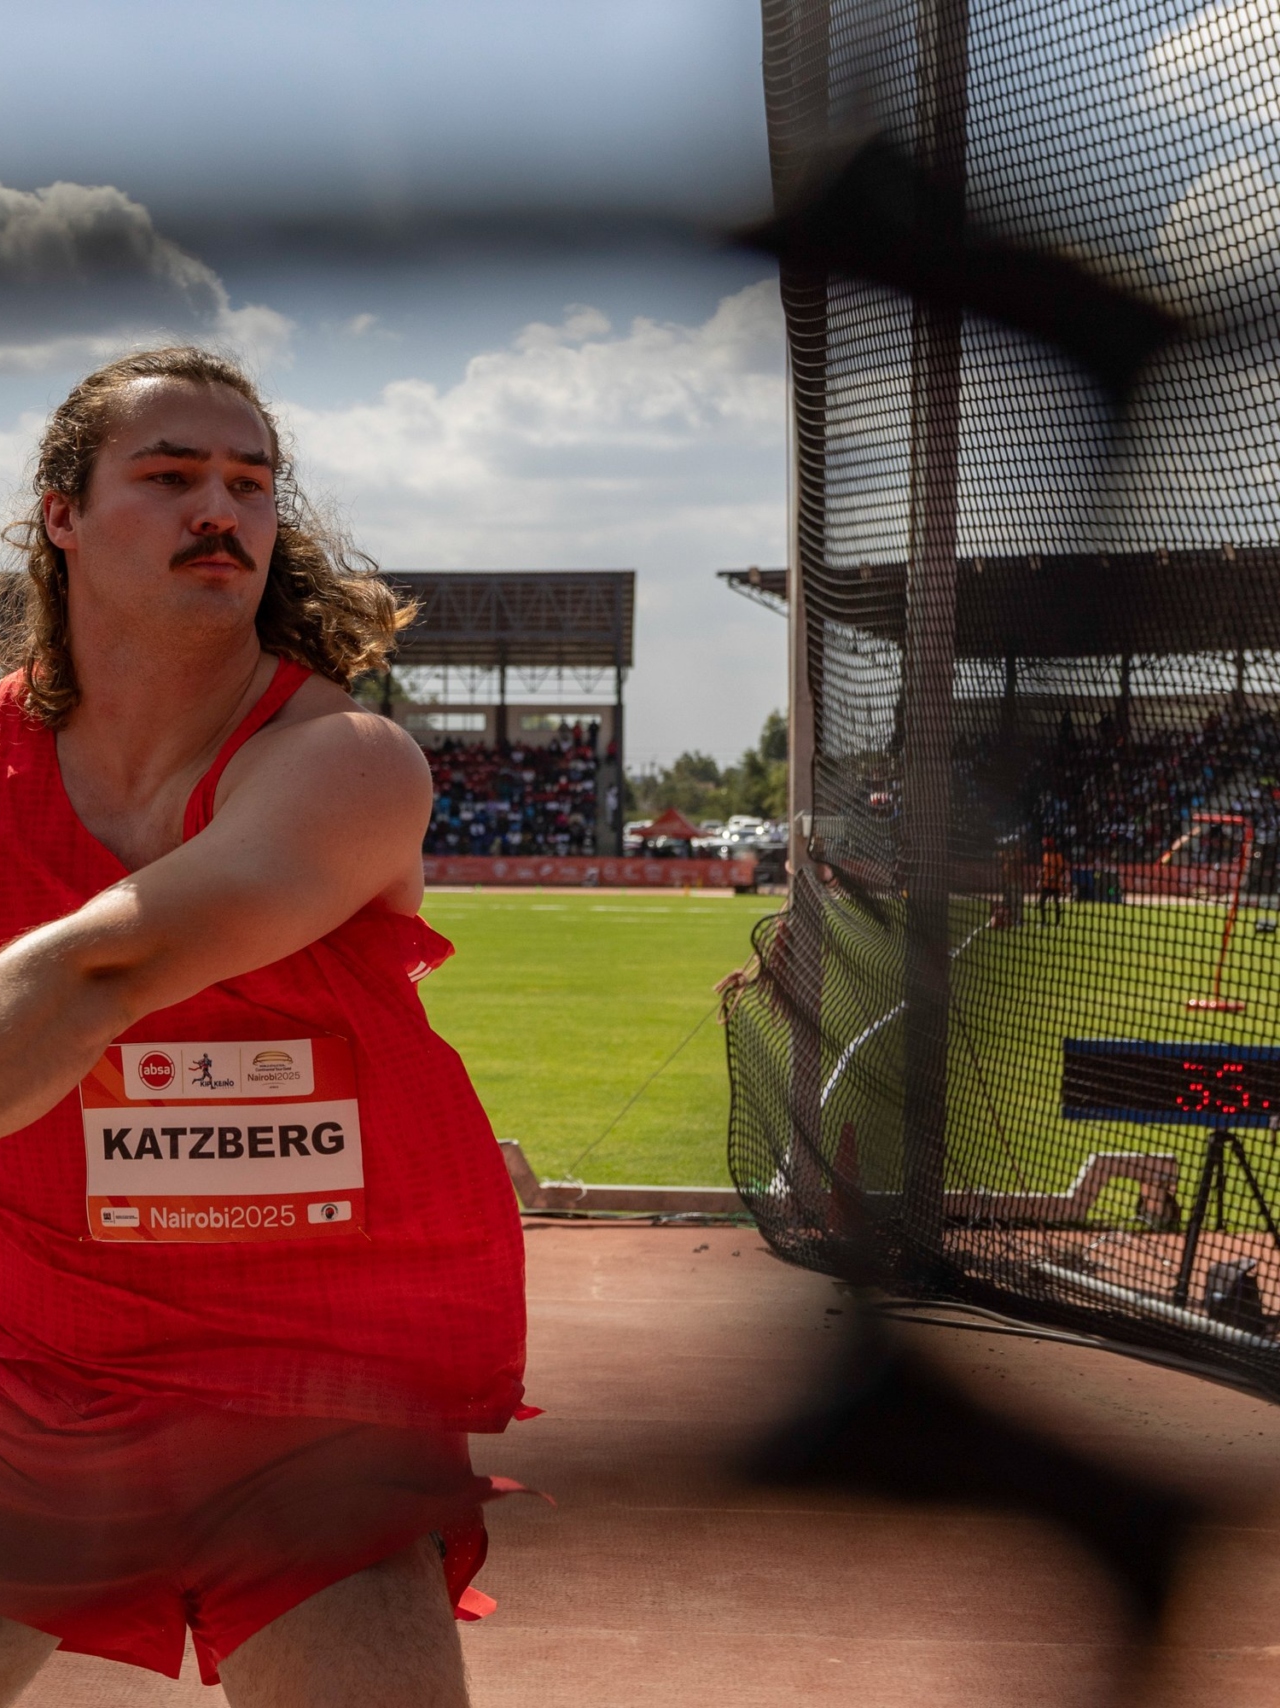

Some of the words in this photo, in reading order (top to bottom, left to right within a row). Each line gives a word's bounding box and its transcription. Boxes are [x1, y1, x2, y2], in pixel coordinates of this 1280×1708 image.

[143, 1063, 171, 1075] absa
[247, 1072, 300, 1082] Nairobi2025
[103, 1122, 345, 1160] KATZBERG
[150, 1205, 296, 1228] Nairobi2025
